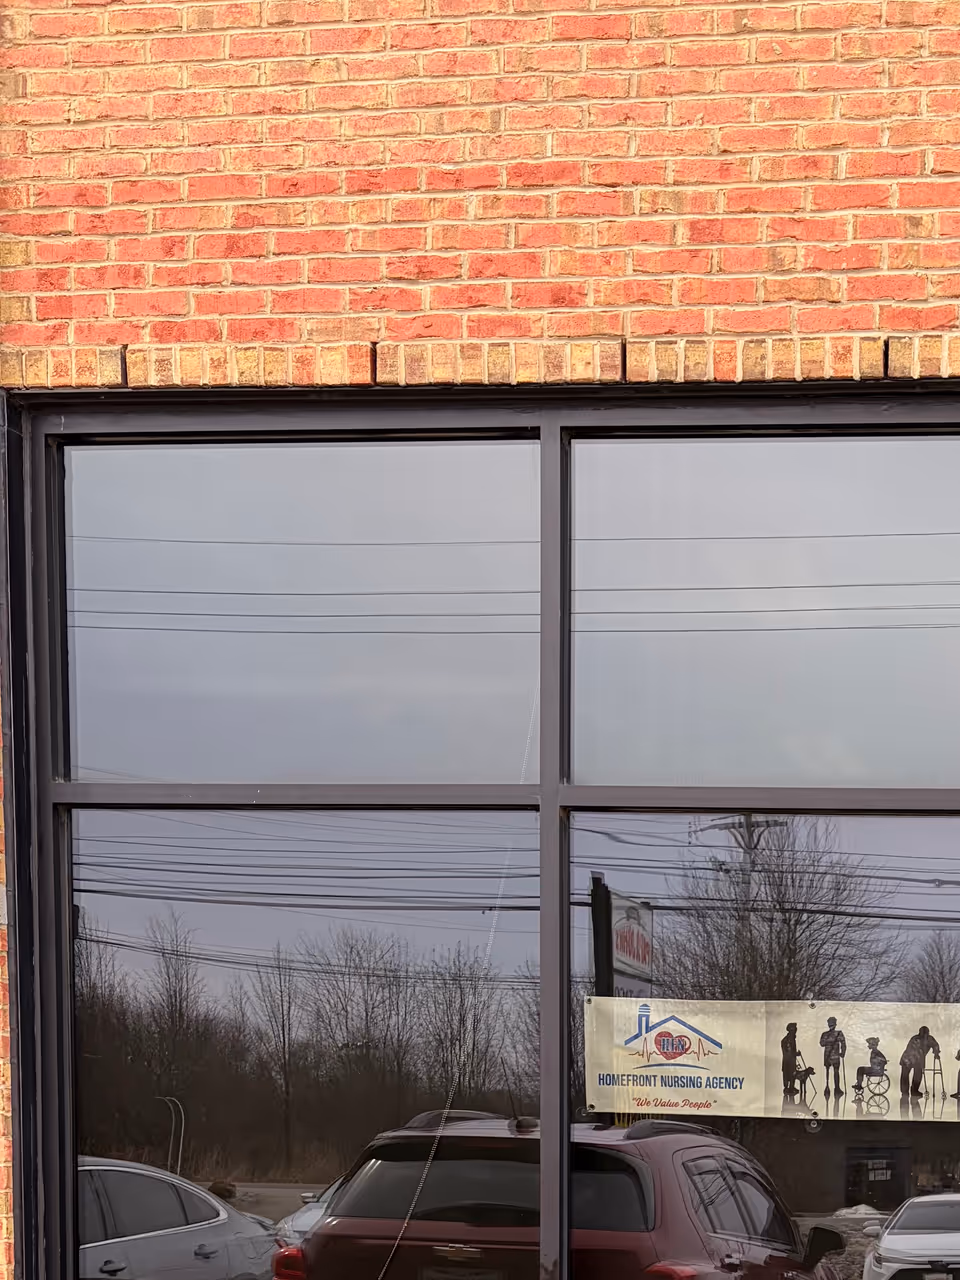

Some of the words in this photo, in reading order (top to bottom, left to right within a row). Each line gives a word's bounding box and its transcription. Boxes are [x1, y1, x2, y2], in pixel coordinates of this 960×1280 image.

[598, 1073, 658, 1087] HOMEFRONT
[660, 1075, 702, 1089] NURSING
[704, 1076, 745, 1090] AGENCY
[652, 1097, 680, 1108] Value
